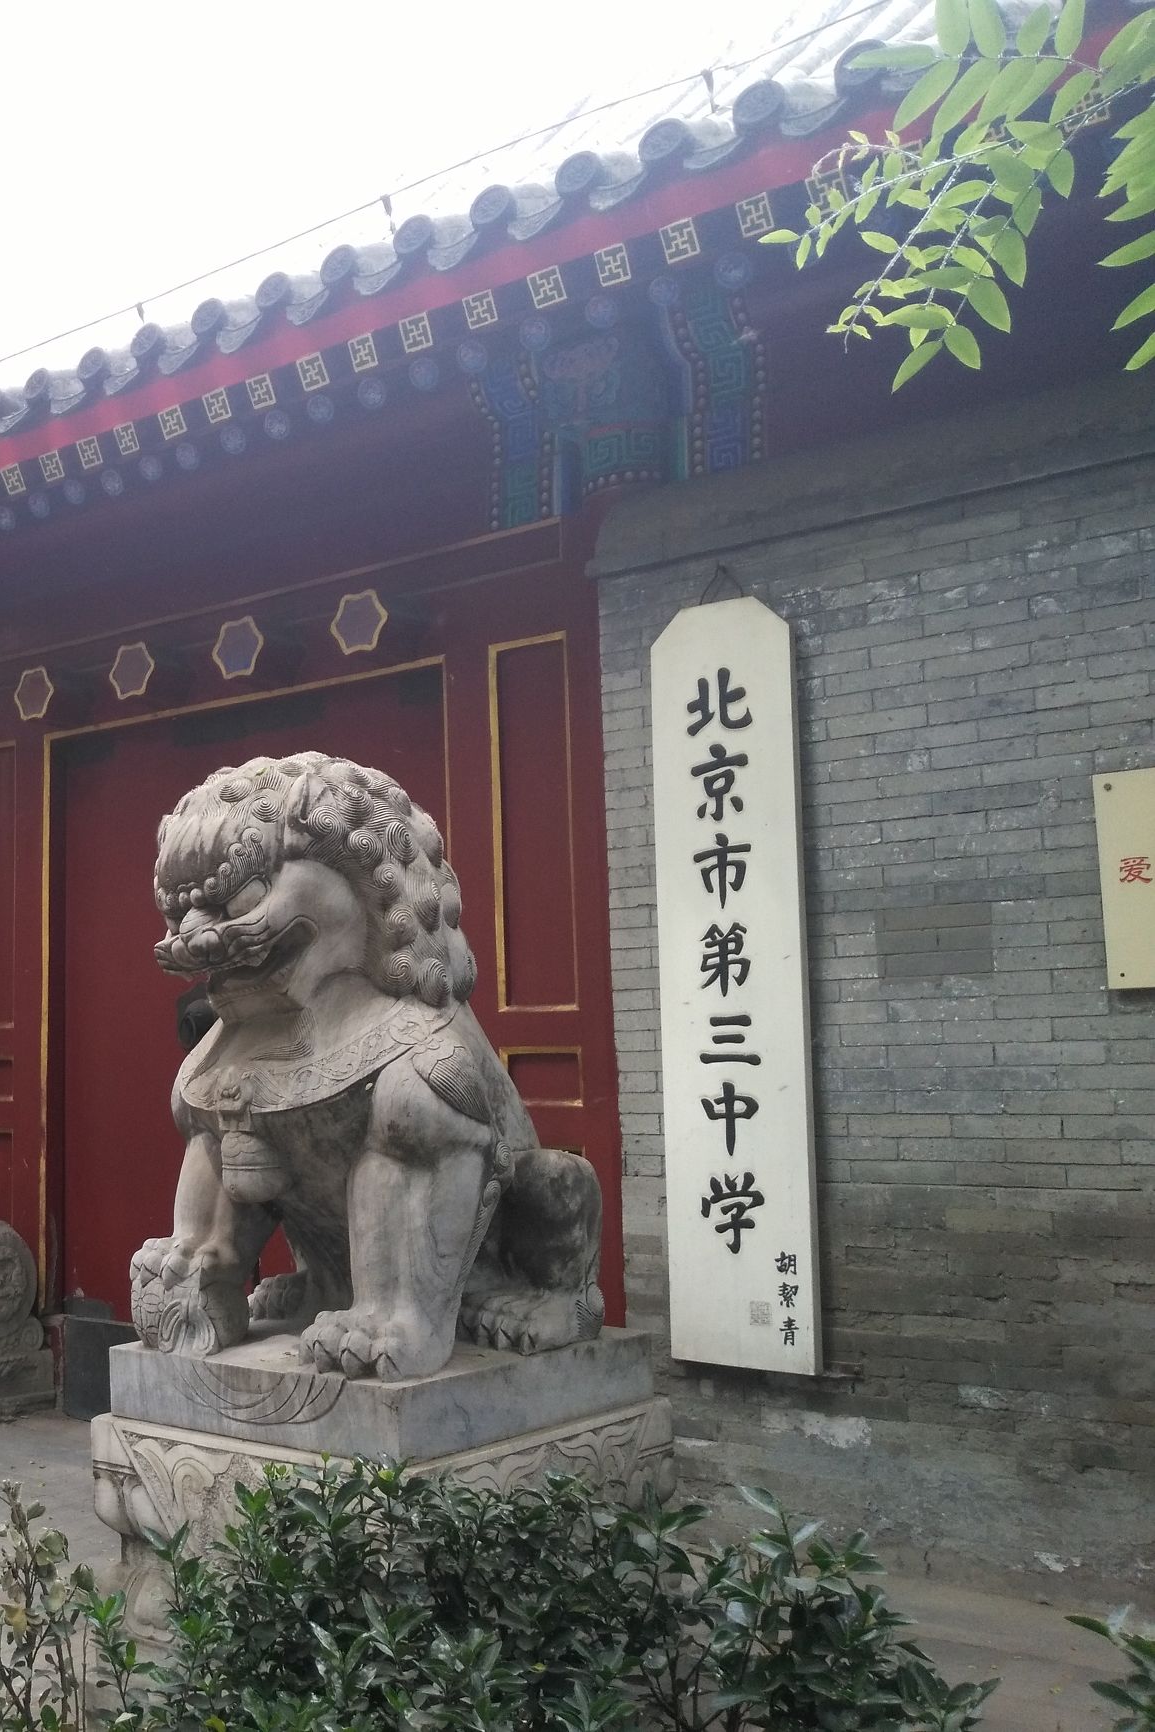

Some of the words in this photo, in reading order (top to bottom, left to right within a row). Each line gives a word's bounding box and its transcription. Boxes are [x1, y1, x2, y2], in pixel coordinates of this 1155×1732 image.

[686, 667, 766, 1255] 北京市第三中学
[1120, 857, 1153, 883] 爱
